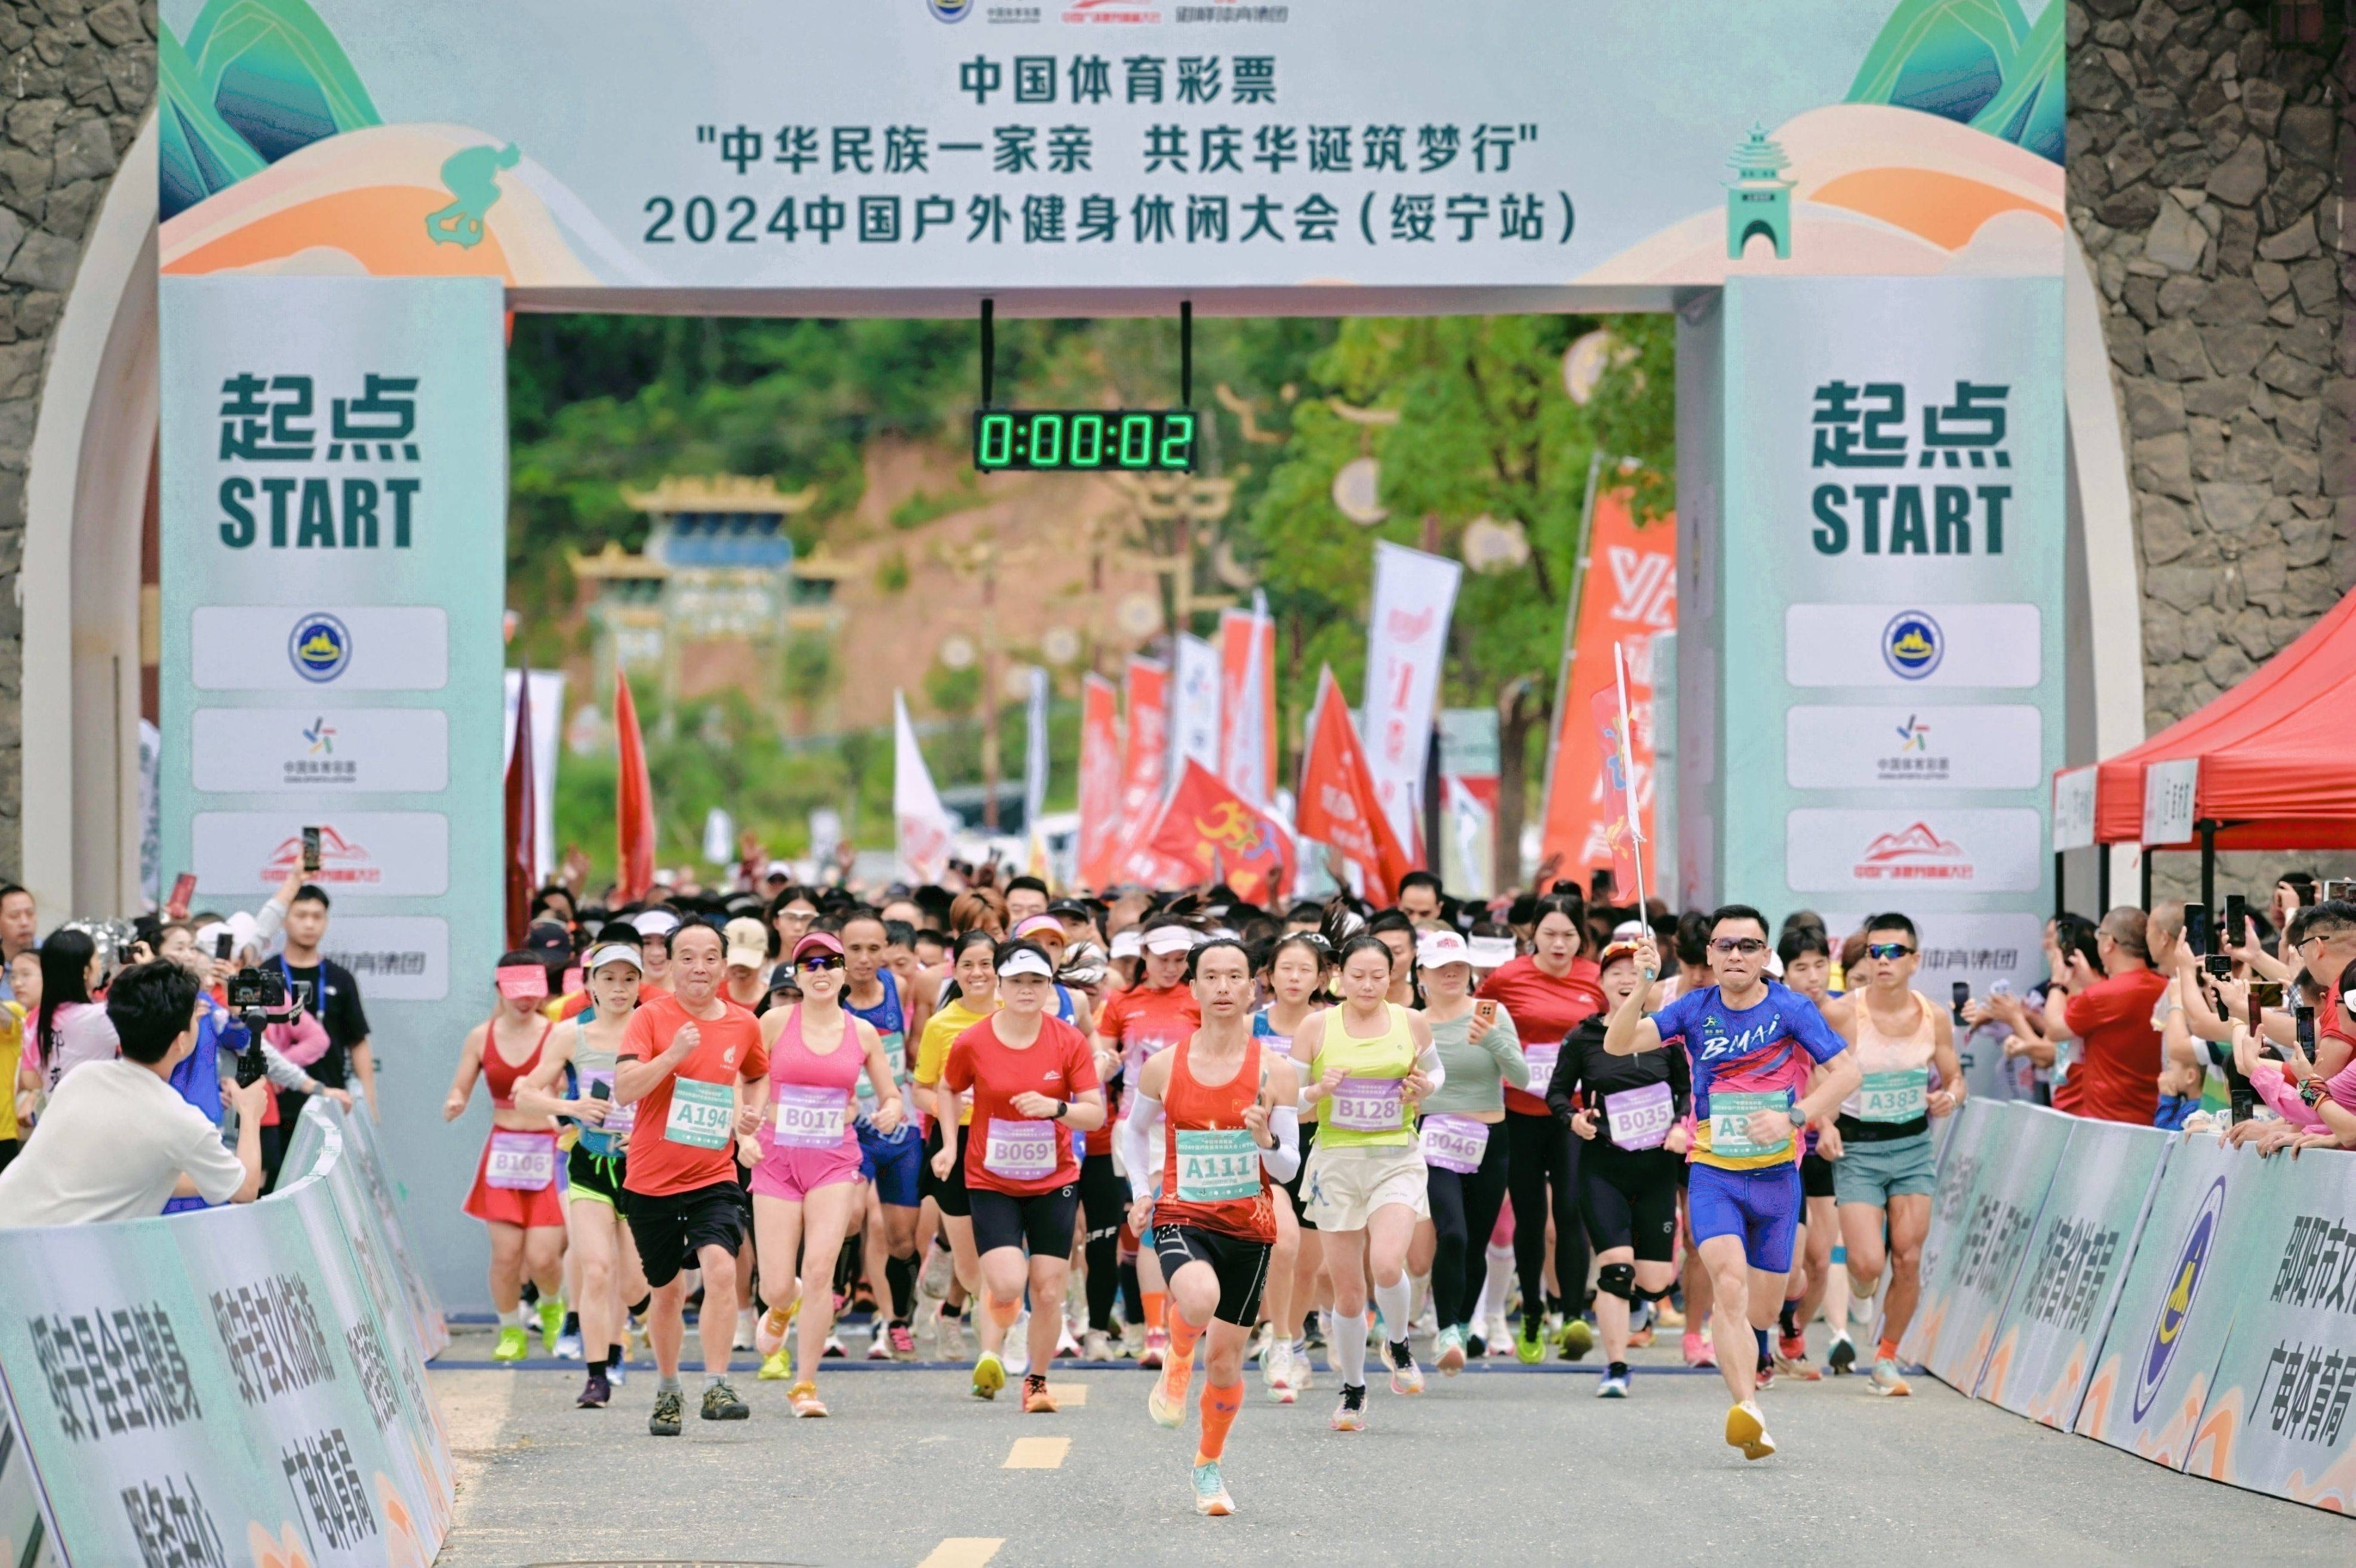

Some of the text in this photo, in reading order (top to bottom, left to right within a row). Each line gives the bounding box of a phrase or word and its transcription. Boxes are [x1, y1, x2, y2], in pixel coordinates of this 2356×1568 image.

[960, 54, 1276, 105] 中国体育彩票
[219, 372, 420, 461] 起点
[980, 414, 1194, 467] 0:00:02
[1811, 380, 2011, 469] 起点
[219, 476, 421, 549] START
[1811, 483, 2012, 556] START
[676, 1103, 727, 1129] A194
[786, 1108, 839, 1129] B017
[1339, 1099, 1395, 1119] B128
[1618, 1104, 1669, 1132] B035
[1869, 1089, 1918, 1110] A383
[496, 1154, 545, 1173] B106
[994, 1142, 1048, 1160] B069
[1186, 1156, 1250, 1179] A111
[1426, 1131, 1477, 1157] B046
[208, 1271, 336, 1407] 绥宁县文化旅游
[28, 1299, 202, 1443] 绥宁县全民健身
[2247, 1339, 2356, 1447] 广电体育局
[281, 1428, 377, 1564] 广电体育局
